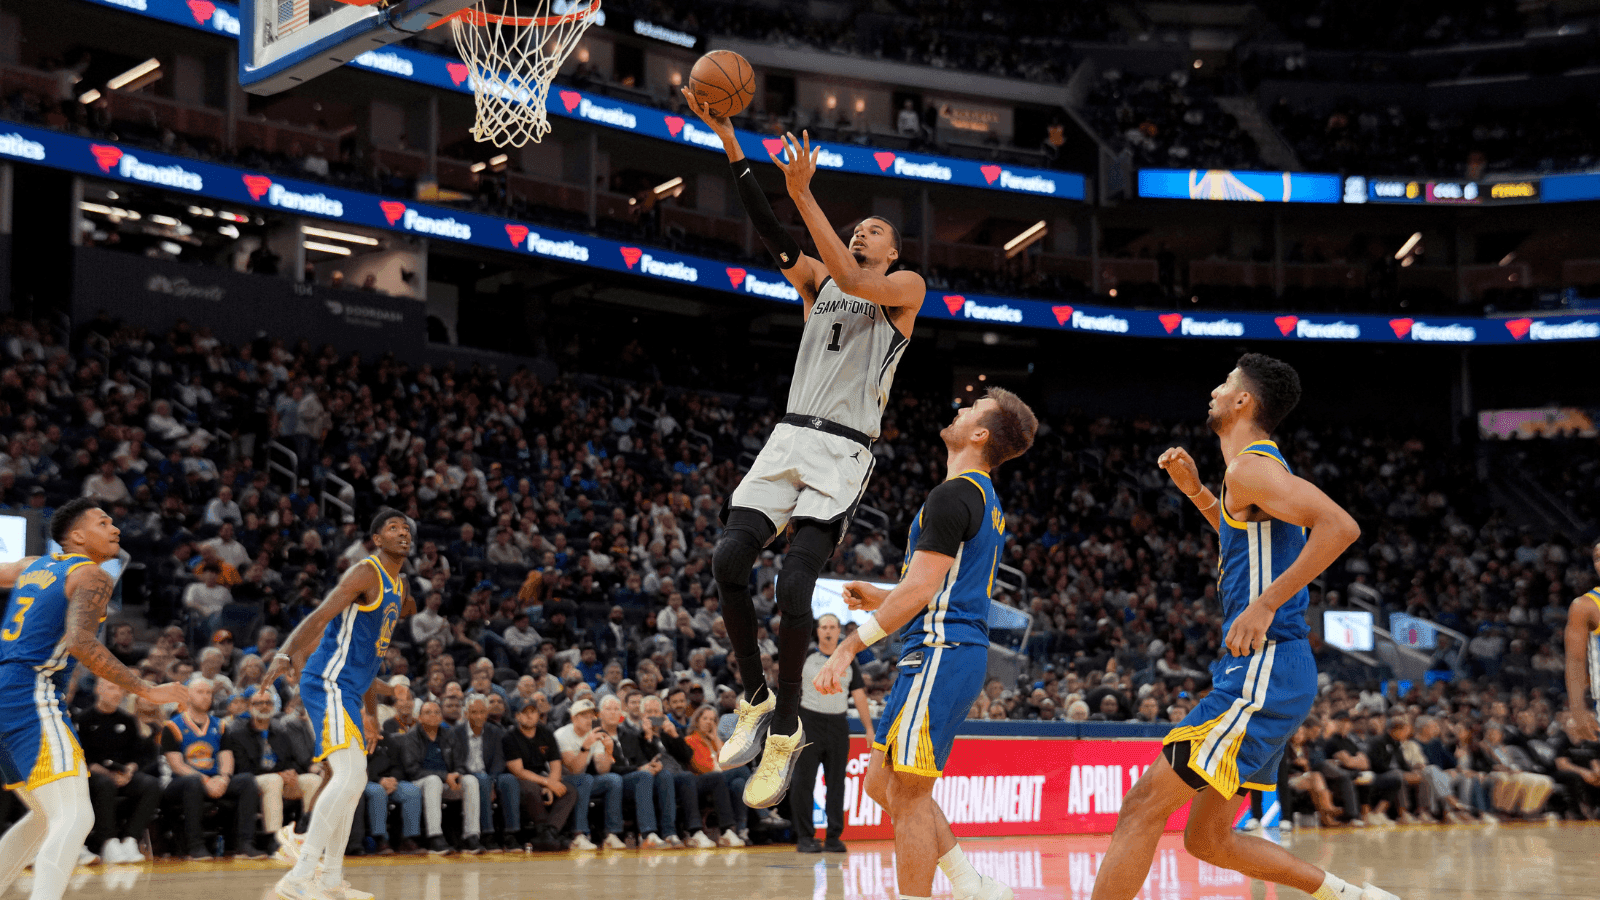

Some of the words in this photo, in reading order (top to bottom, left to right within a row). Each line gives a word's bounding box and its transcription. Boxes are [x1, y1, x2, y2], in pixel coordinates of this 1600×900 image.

[351, 50, 414, 76] anatics
[119, 153, 203, 191] Fanatics
[894, 157, 952, 181] Fanatics
[999, 170, 1056, 194] Fanatics
[268, 183, 344, 217] Fanatics
[404, 209, 472, 240] Fanatics
[527, 232, 589, 262] Fanatics
[640, 254, 698, 282] Fanatics
[964, 300, 1023, 323] Fanatics
[1071, 310, 1129, 333] Fanatics
[826, 322, 843, 352] 1
[1181, 317, 1244, 337] Fanatics
[1296, 319, 1360, 339] Fanatics
[1411, 321, 1475, 341] Fanatics
[1529, 320, 1600, 340] Fanatics
[2, 596, 35, 641] 3
[931, 775, 1046, 825] OURNAMENT
[1067, 764, 1123, 815] APRIL
